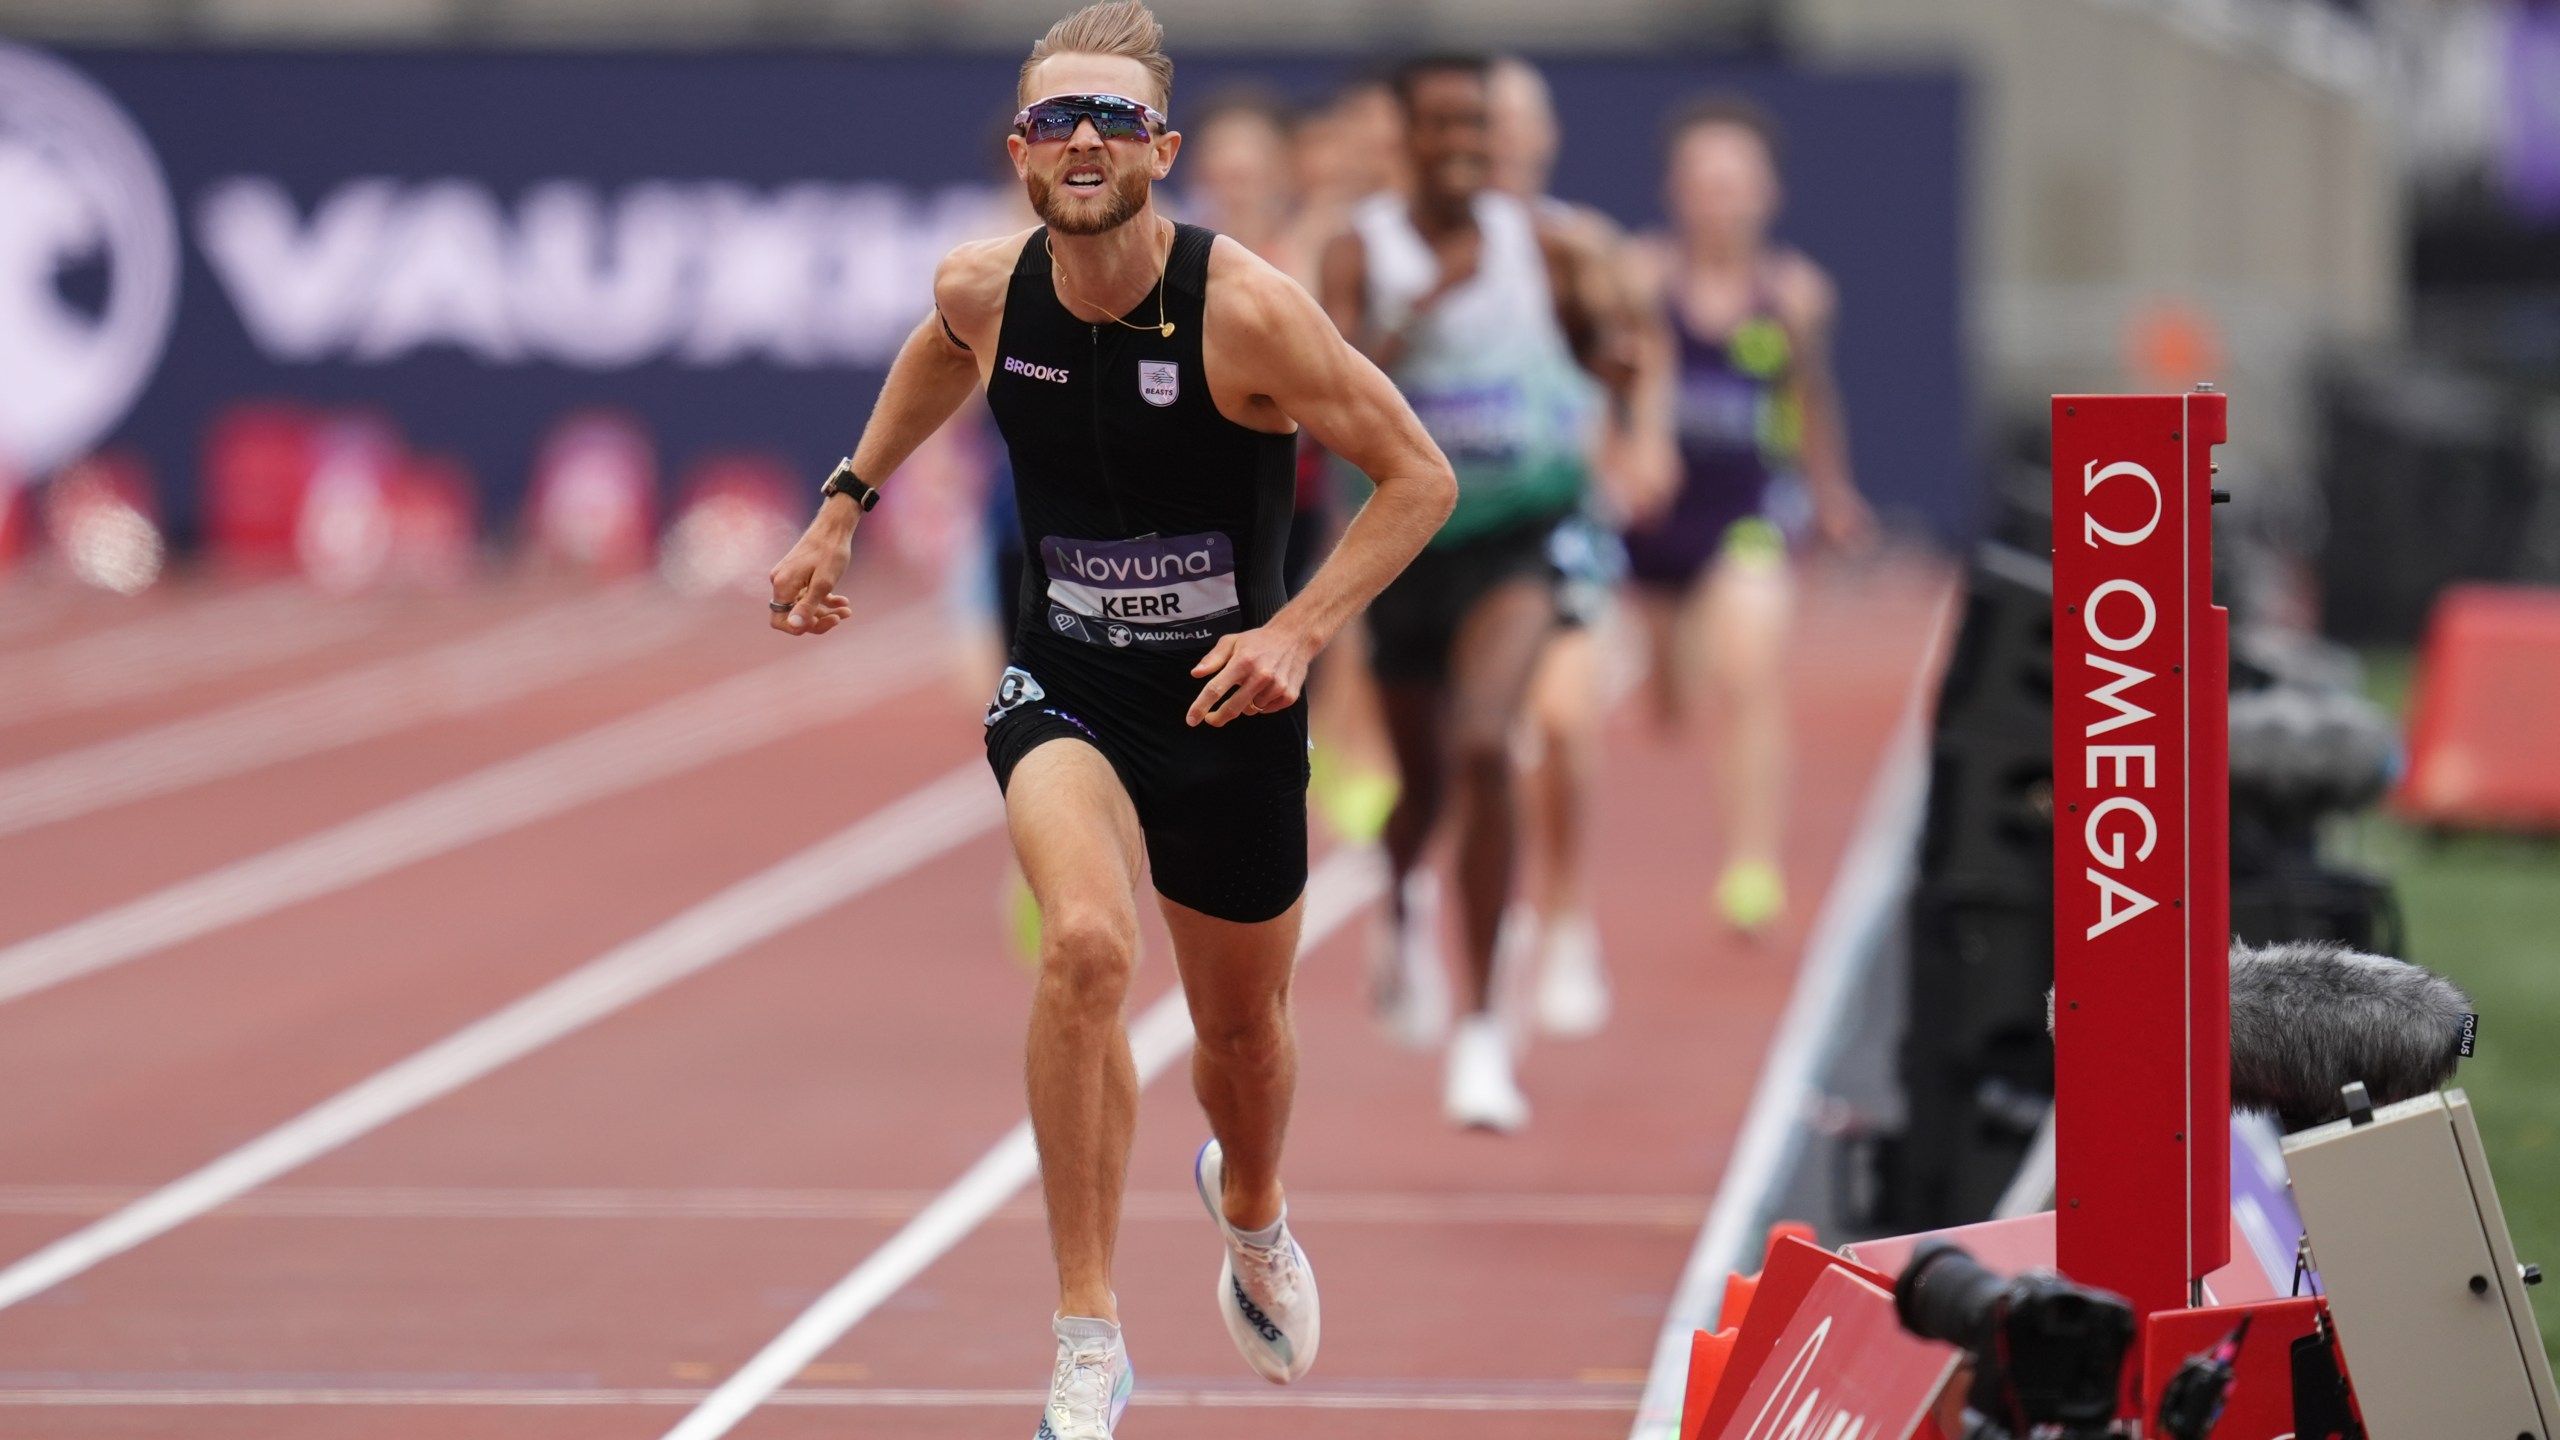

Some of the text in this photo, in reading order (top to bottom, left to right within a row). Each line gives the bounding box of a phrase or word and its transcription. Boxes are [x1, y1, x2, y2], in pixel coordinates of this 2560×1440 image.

[1004, 356, 1070, 384] BROOKS
[1145, 387, 1173, 396] BEASTS
[1101, 592, 1183, 618] KERR
[1134, 628, 1213, 642] VAUXHALL
[2083, 578, 2160, 942] OMEGA
[2460, 1014, 2475, 1055] radius
